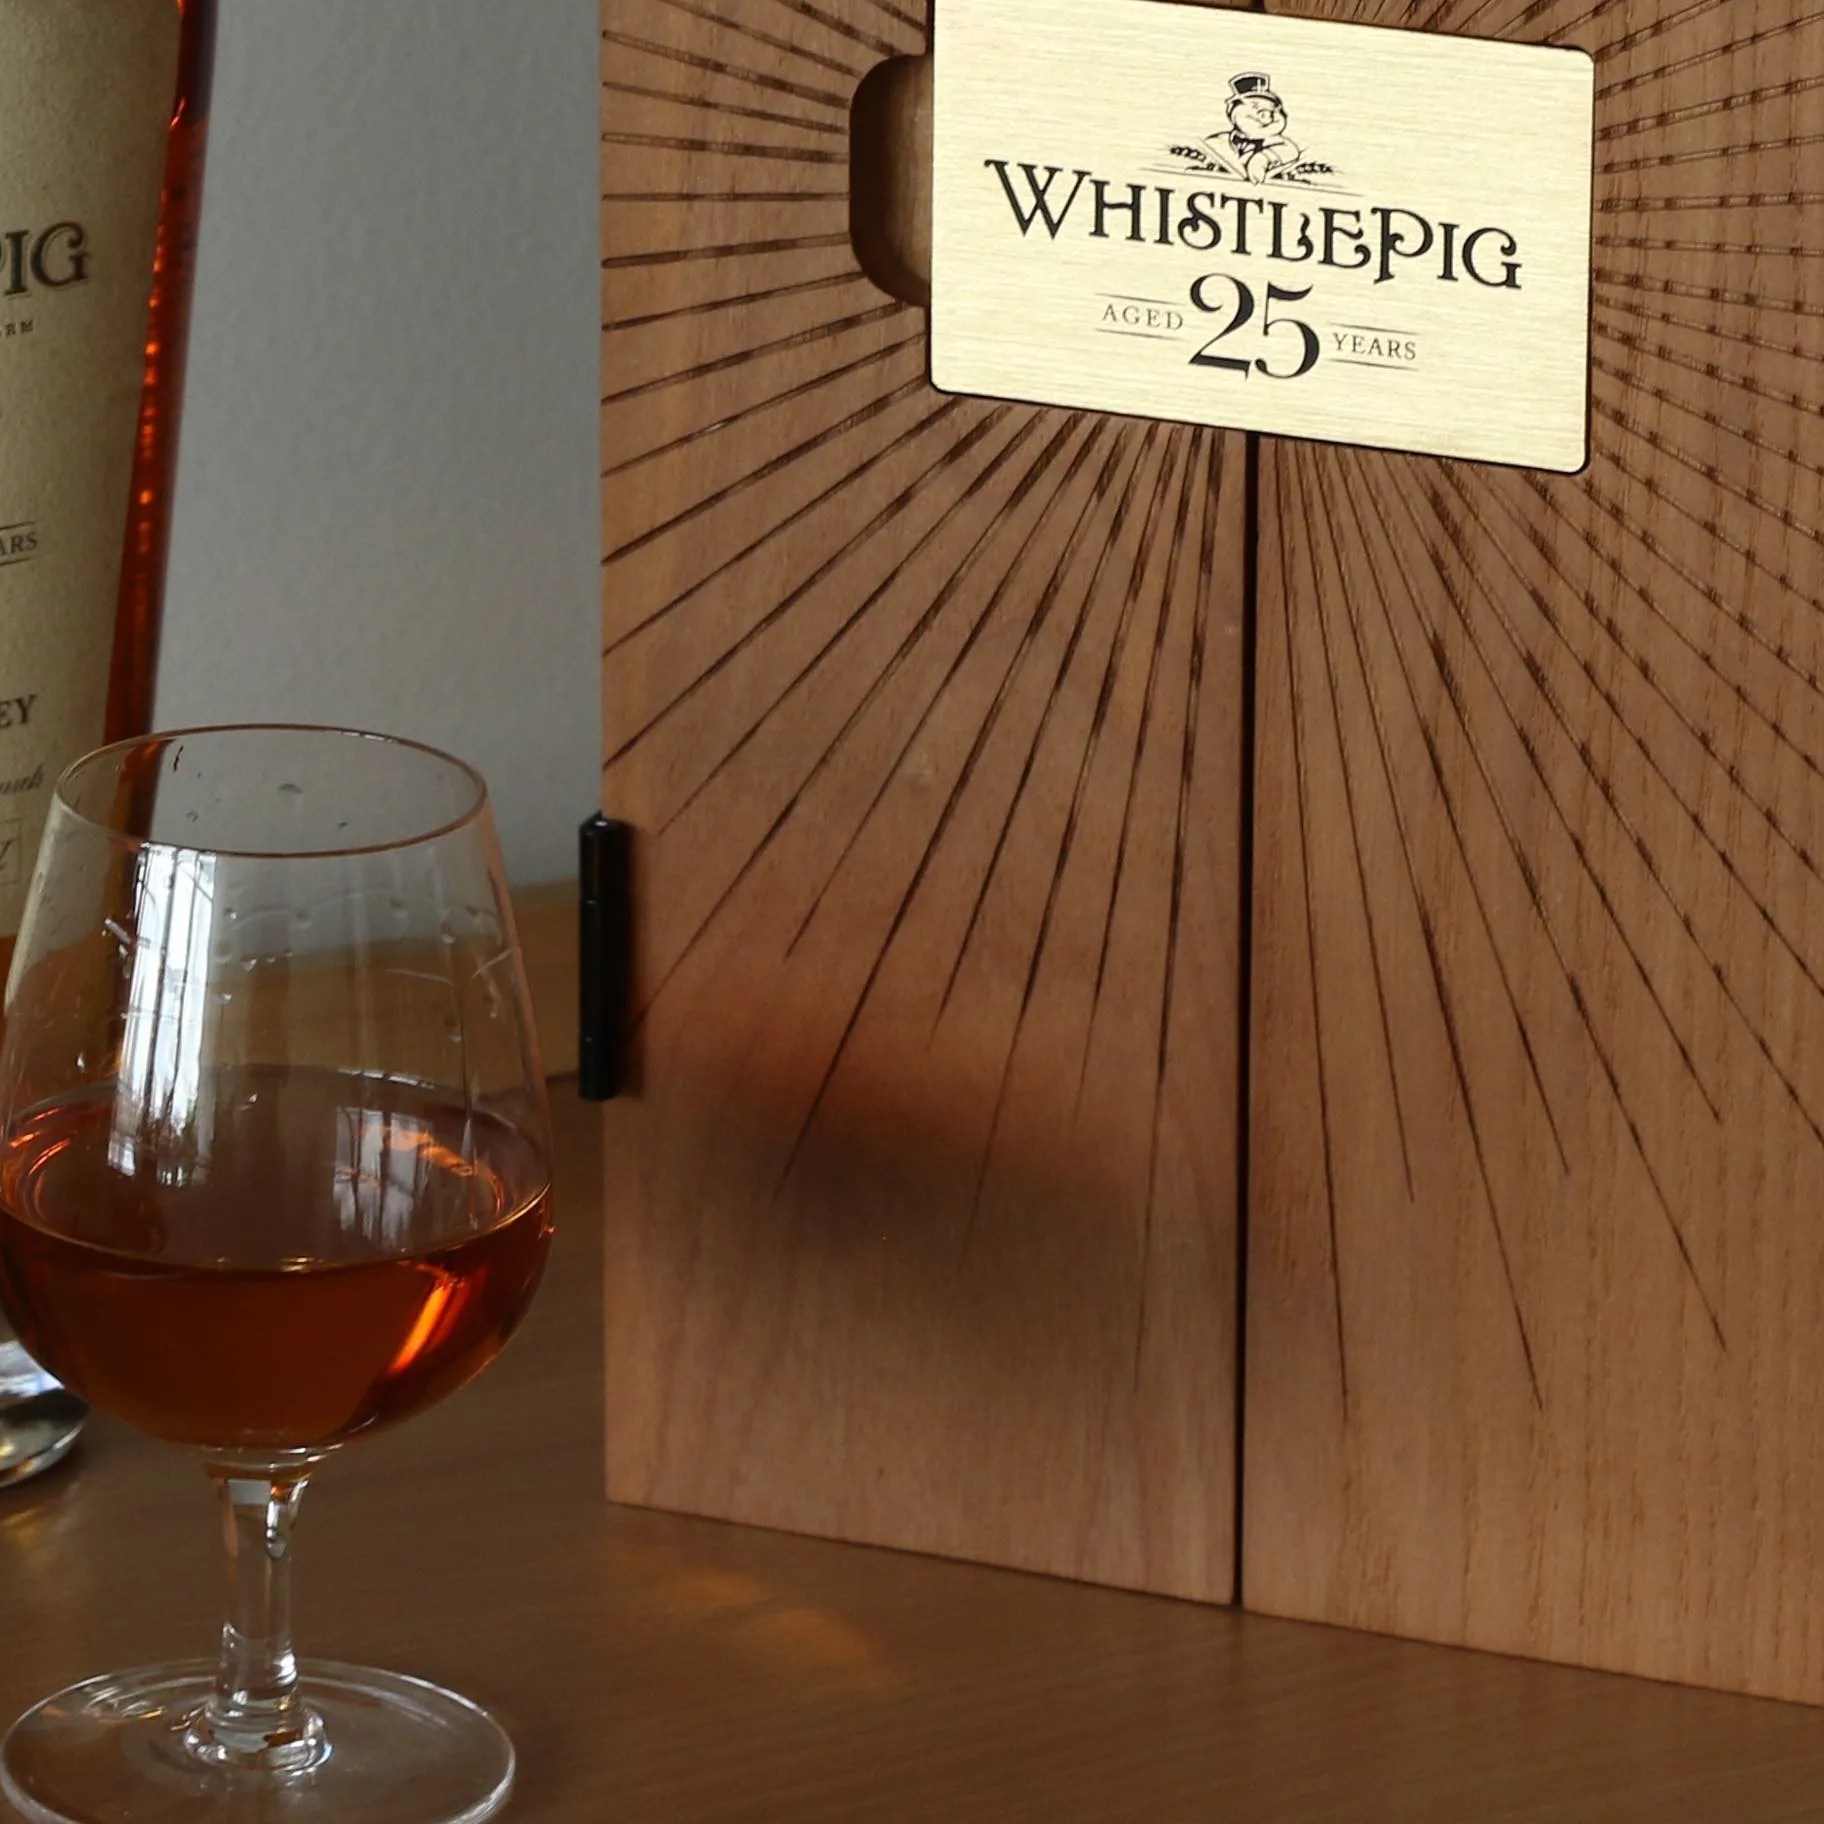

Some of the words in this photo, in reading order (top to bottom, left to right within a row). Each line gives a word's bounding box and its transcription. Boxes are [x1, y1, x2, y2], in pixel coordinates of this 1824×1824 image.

[983, 157, 1524, 292] WHISTLEPIG
[1101, 303, 1185, 332] AGED
[1188, 272, 1321, 380] 25
[1331, 331, 1419, 362] YEARS
